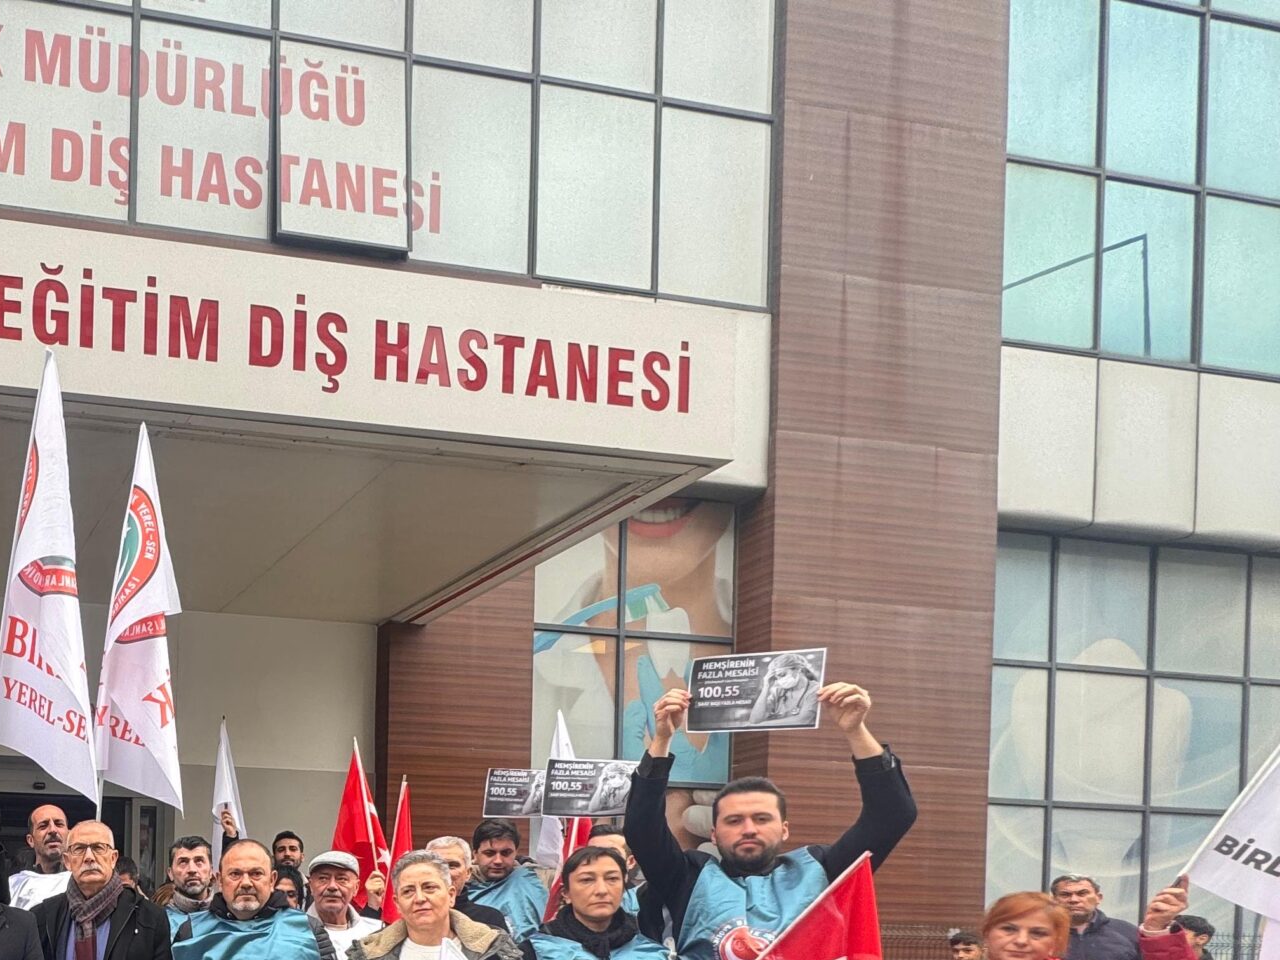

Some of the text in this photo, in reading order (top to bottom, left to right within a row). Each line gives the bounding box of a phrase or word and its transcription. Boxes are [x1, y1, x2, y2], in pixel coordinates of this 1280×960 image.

[23, 24, 367, 127] MÜDÜRLÜĞÜ
[51, 120, 130, 206] DİŞ
[160, 144, 441, 234] HASTANESİ
[248, 293, 348, 394] DİŞ
[373, 318, 690, 414] HASTANESİ
[697, 670, 723, 679] FAZLA
[698, 685, 740, 699] 100,55
[3, 676, 89, 744] YEREL-SE
[490, 787, 517, 797] 100,55
[551, 781, 582, 791] 100,55
